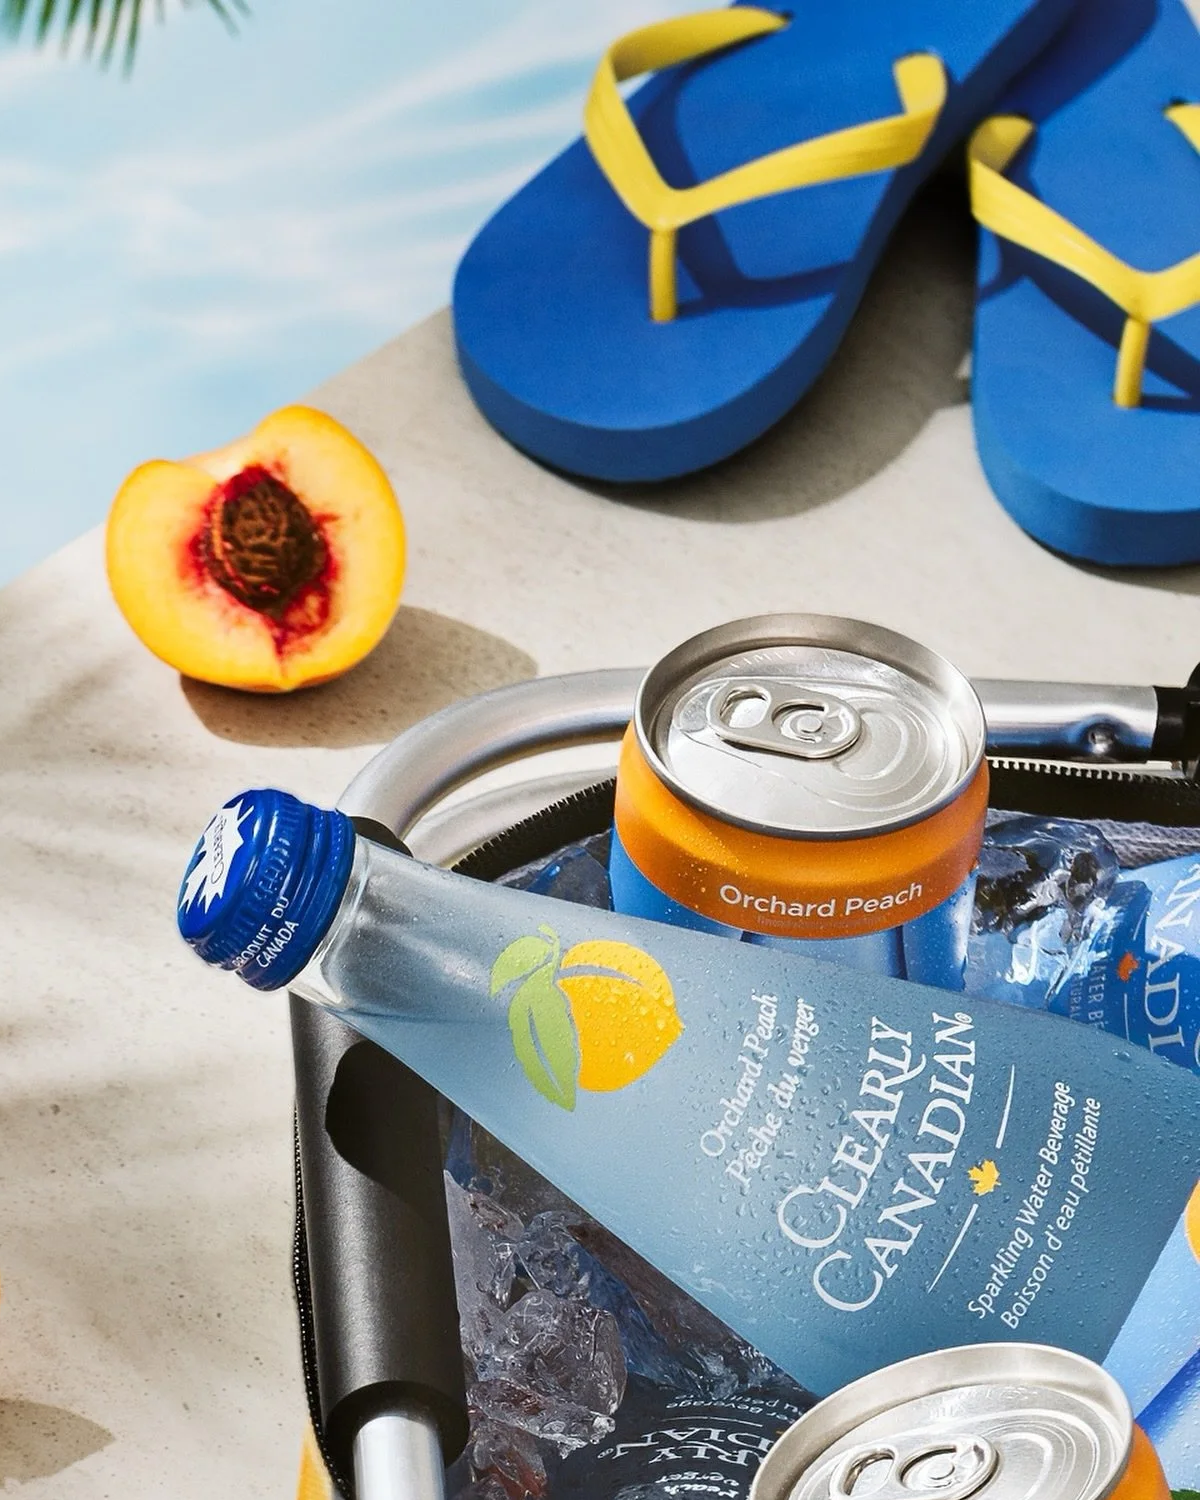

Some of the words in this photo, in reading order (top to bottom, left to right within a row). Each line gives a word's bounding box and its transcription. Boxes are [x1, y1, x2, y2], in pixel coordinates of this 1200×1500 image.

[231, 924, 272, 966] PRODUIT
[271, 897, 289, 919] DU
[256, 921, 299, 968] CANADA
[719, 884, 836, 917] Orchard
[845, 882, 923, 916] Peach
[700, 1055, 762, 1156] Orchard
[743, 990, 778, 1060] Peach
[725, 1112, 782, 1192] Pêche
[768, 1072, 800, 1108] du
[788, 998, 819, 1067] verger
[778, 1016, 926, 1249] CLEARLY
[967, 1227, 1034, 1319] Sparkling
[1015, 1163, 1054, 1226] Water
[1039, 1081, 1076, 1165] Beverage
[1000, 1252, 1054, 1330] Boisson
[1047, 1191, 1081, 1251] d'eau
[1070, 1097, 1101, 1193] pétillante
